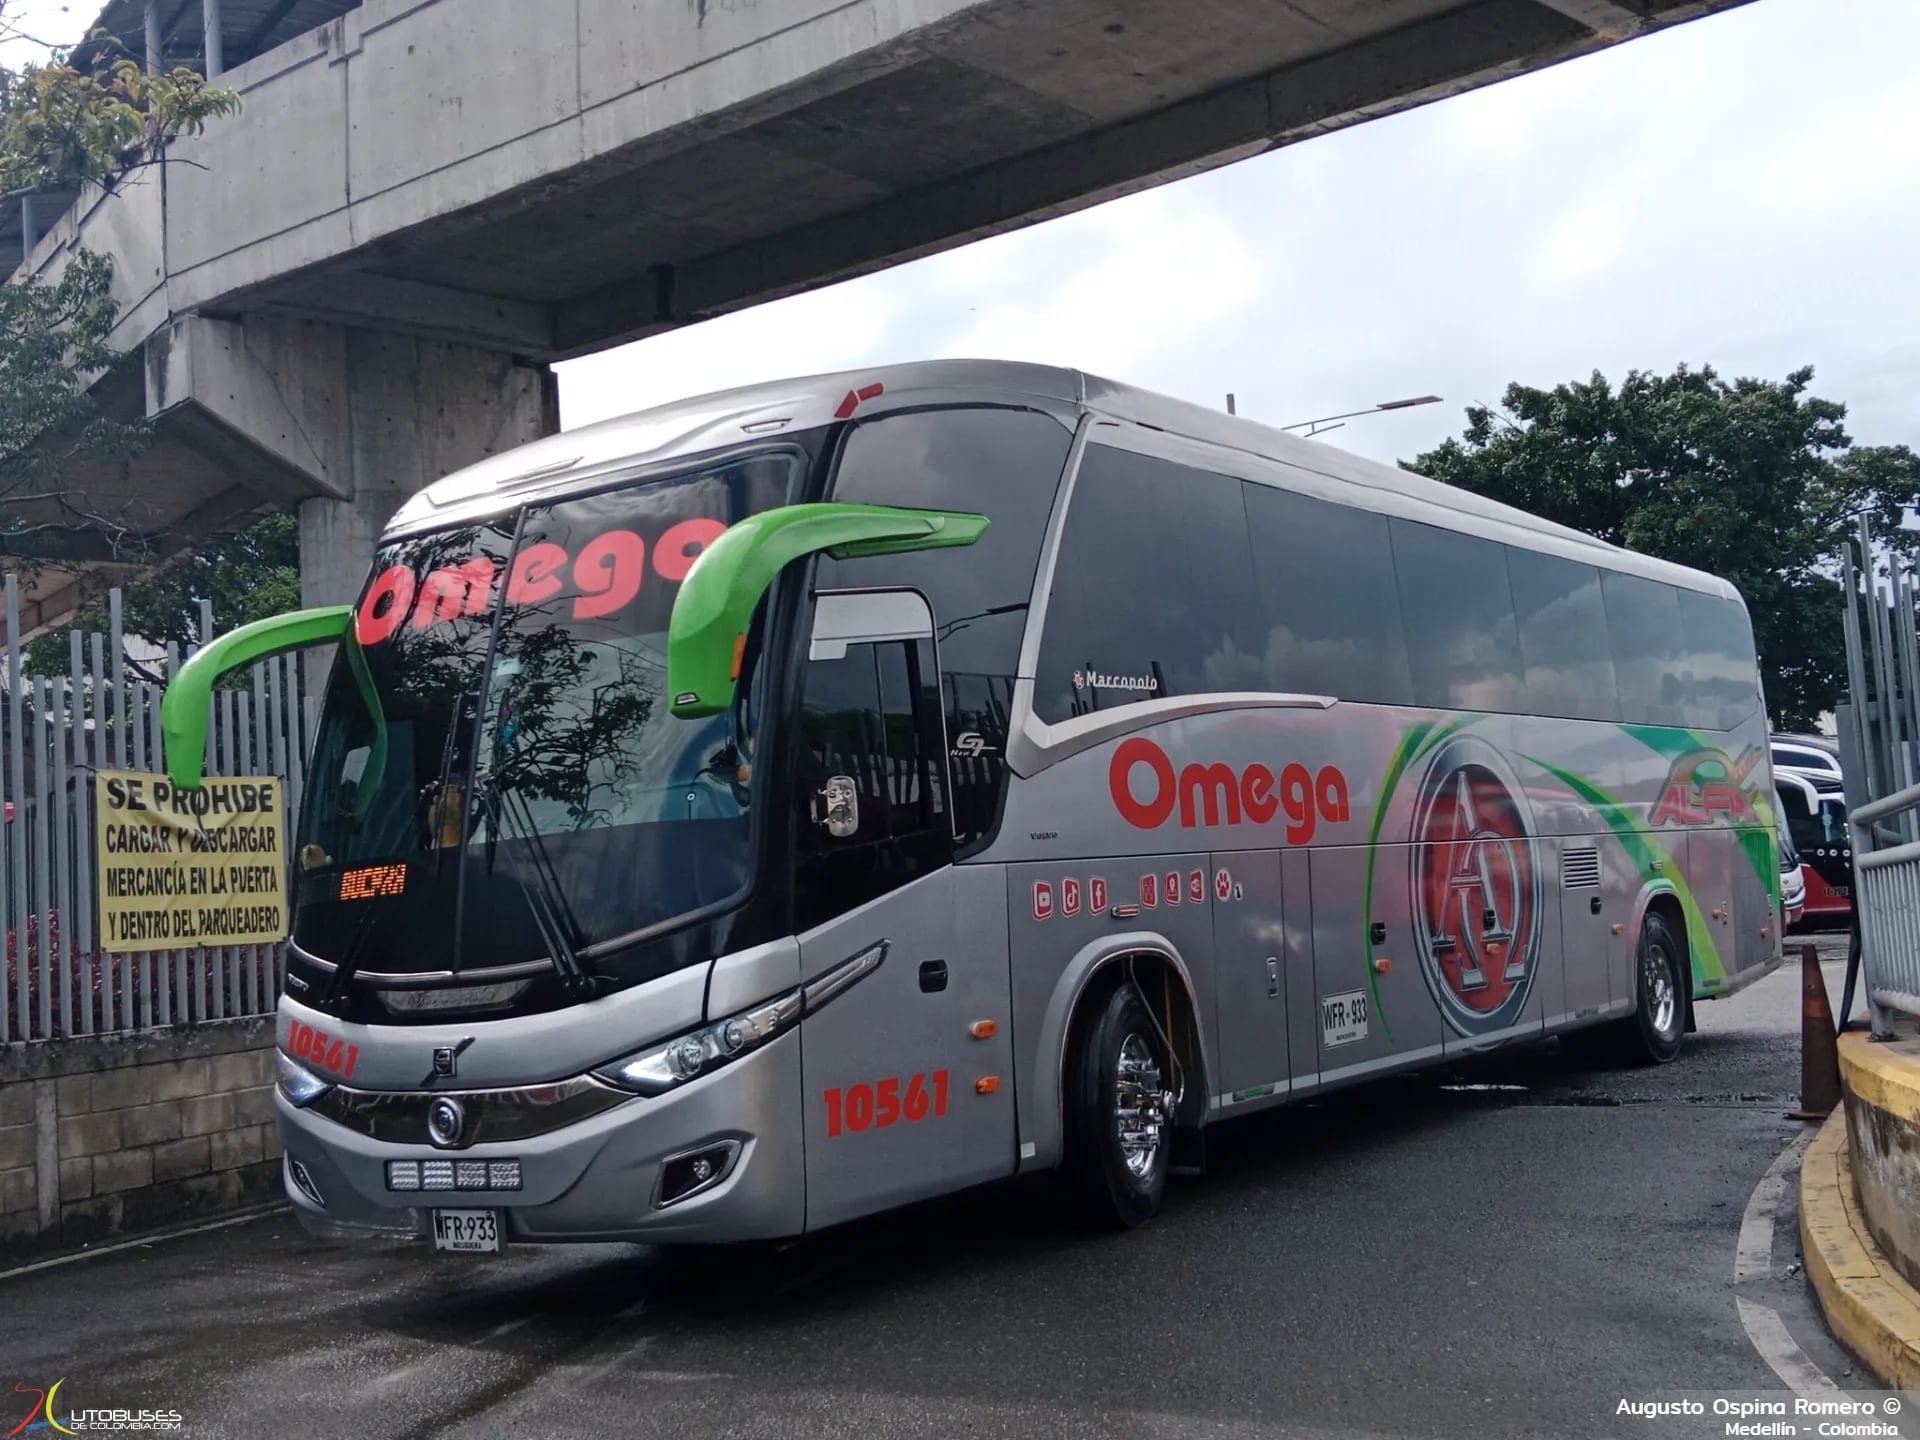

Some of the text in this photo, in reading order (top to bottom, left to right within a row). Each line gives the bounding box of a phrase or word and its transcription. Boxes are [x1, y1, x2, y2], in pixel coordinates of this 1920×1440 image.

[1086, 671, 1158, 691] Marcopolo
[107, 777, 274, 815] SE PROHIBE
[1109, 737, 1349, 846] Omega
[1651, 784, 1758, 826] ALFA
[106, 824, 276, 853] CARGAR Y DESCARGAR
[107, 860, 278, 897] MERCANCÍA EN LA PUERTA
[108, 906, 280, 941] Y DENTRO DEL PARQUEADERO
[288, 1020, 360, 1080] 10561
[823, 1068, 949, 1138] 10561
